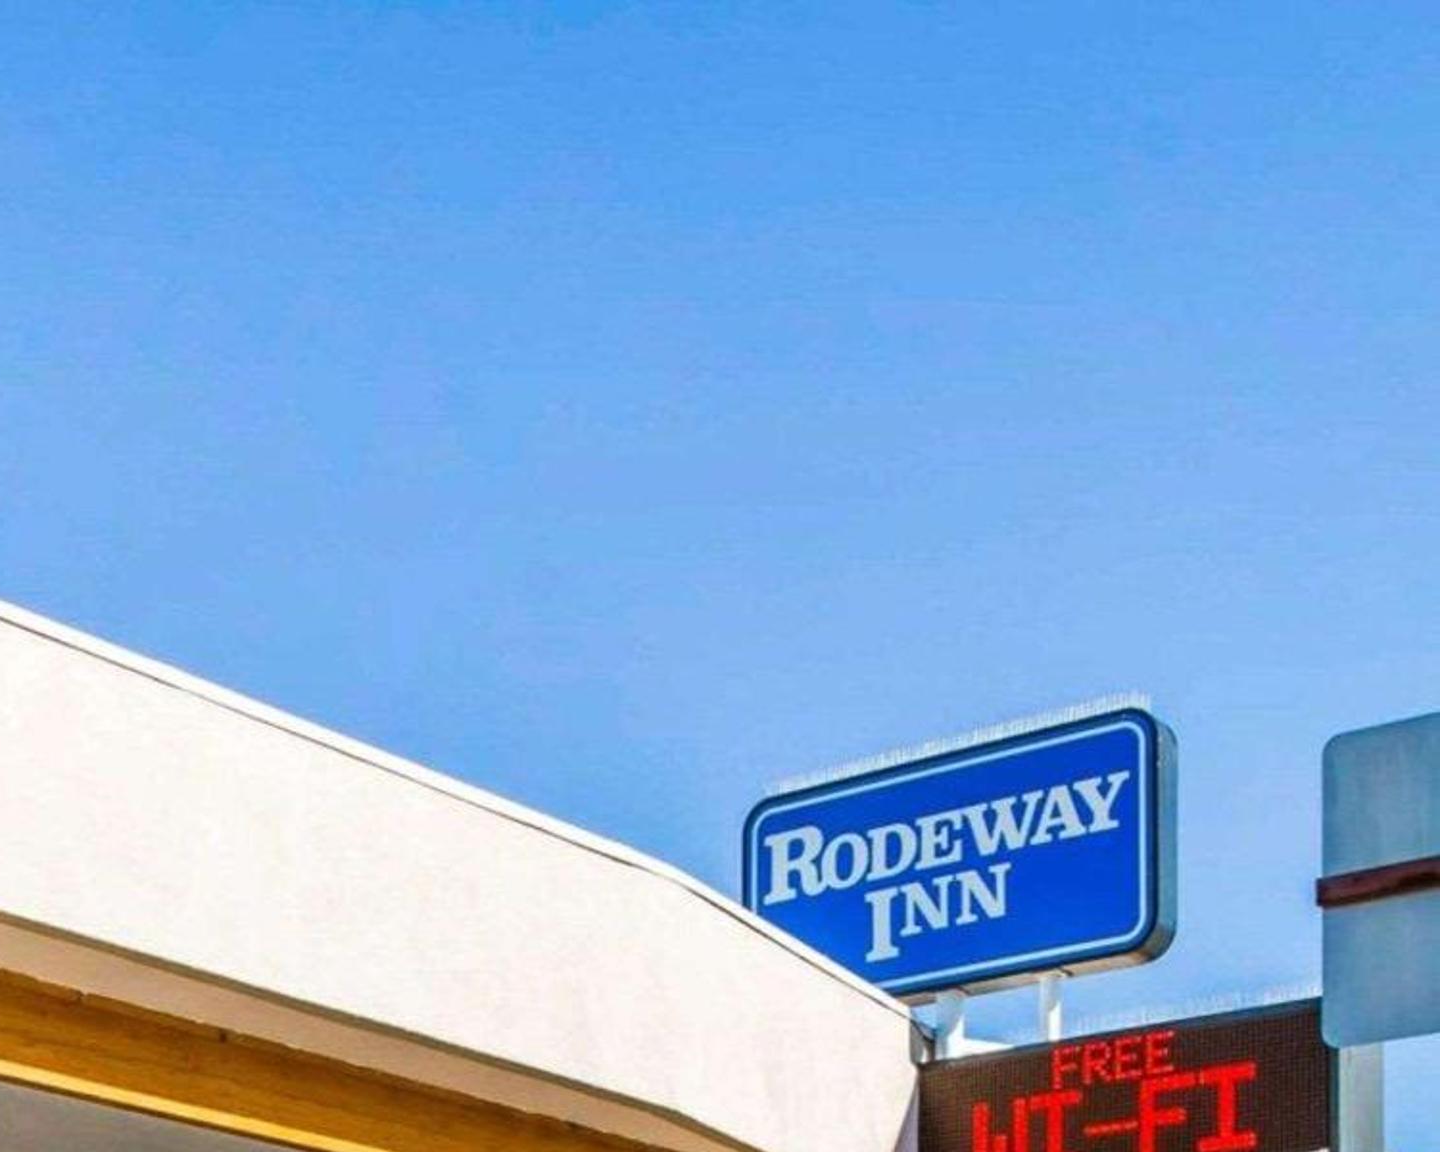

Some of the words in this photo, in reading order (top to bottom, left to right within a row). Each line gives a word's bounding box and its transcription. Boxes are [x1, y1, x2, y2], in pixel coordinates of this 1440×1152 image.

[764, 770, 1130, 906] RODEWAY
[864, 862, 1013, 962] INN
[1050, 1029, 1178, 1090] FREE
